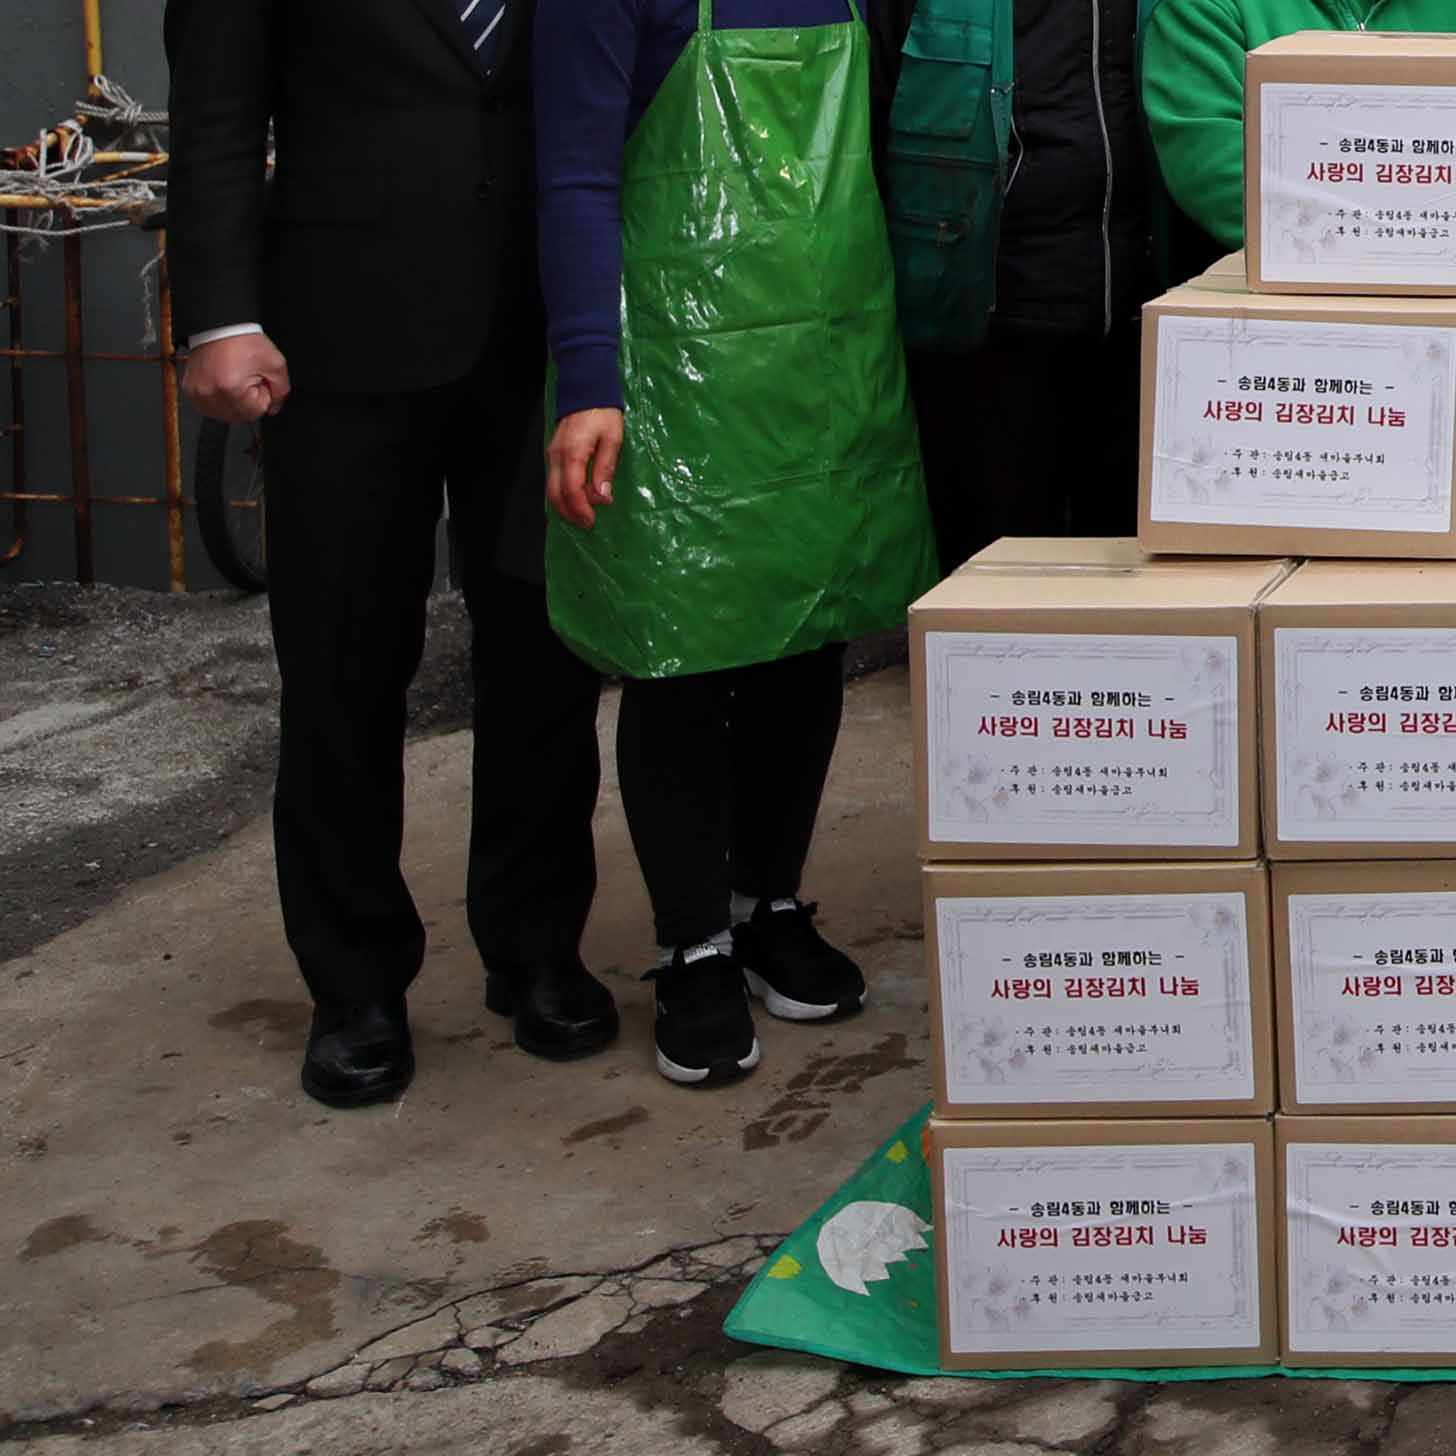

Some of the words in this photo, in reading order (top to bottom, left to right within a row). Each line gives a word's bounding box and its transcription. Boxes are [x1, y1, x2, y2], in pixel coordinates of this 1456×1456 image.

[1306, 160, 1364, 184] 사랑의
[1375, 162, 1453, 186] 김장김치
[1237, 374, 1307, 394] 송림4동과
[1313, 377, 1374, 397] 함께하는
[1202, 398, 1264, 424] 사랑의
[1274, 401, 1356, 427] 김장김치
[1367, 404, 1407, 429] 나눔
[1359, 684, 1431, 704] 송림4동과
[977, 714, 1039, 739] 사랑의
[1051, 715, 1135, 740] 김장김치
[1147, 717, 1188, 741] 나눔
[1325, 710, 1387, 735] 사랑의
[1024, 950, 1094, 970] 송림4동과
[1100, 949, 1163, 970] 함께하는
[990, 977, 1052, 1001] 사랑의
[1063, 975, 1147, 1000] 김장김치
[1159, 975, 1200, 998] 나눔
[1341, 974, 1405, 999] 사랑의
[1369, 1198, 1441, 1218] 송림4동과
[996, 1226, 1059, 1250] 사랑의
[1068, 1222, 1155, 1249] 김장김치
[1167, 1223, 1208, 1247] 나눔
[1336, 1224, 1398, 1250] 사랑의
